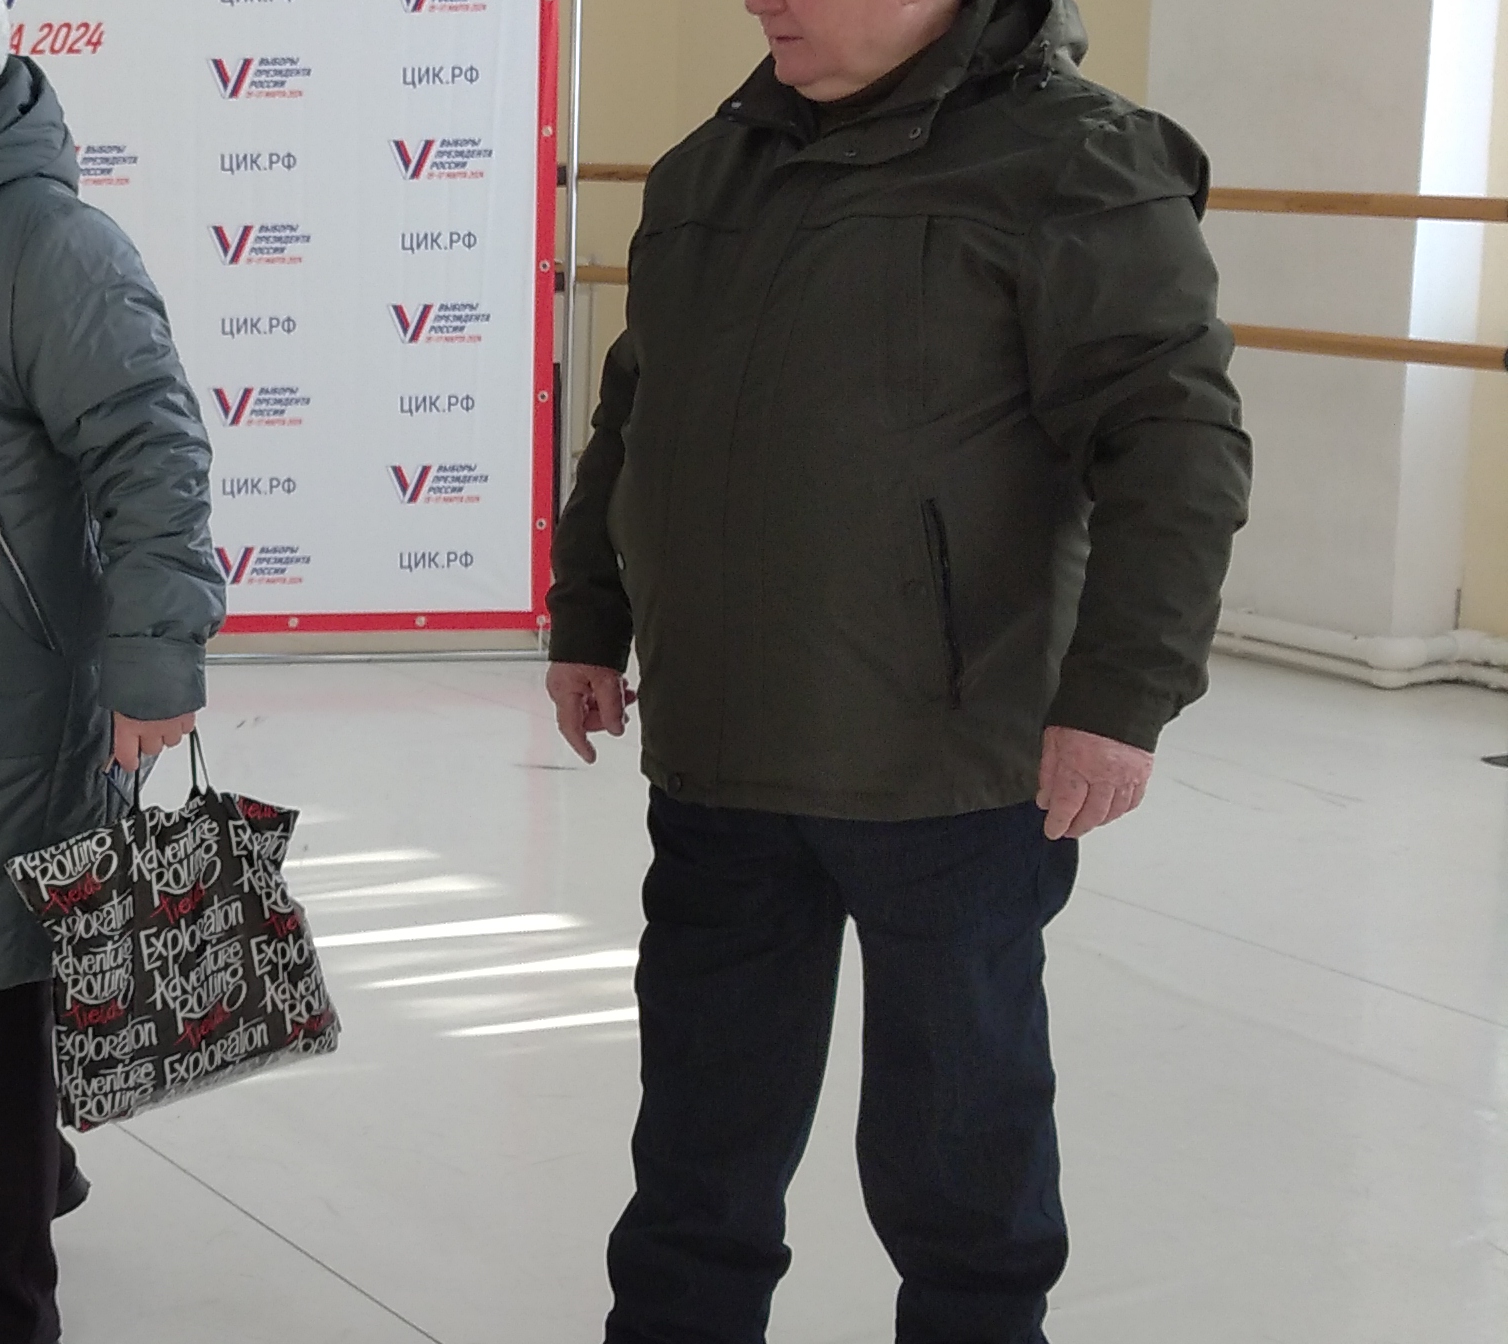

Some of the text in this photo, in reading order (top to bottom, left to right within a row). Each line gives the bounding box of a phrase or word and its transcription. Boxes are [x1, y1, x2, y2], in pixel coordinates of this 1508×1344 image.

[30, 21, 105, 55] 2024
[402, 64, 480, 89] ЦИК.РФ
[220, 151, 298, 176] ЦИК.РФ
[400, 230, 478, 255] ЦИК.РФ
[220, 315, 297, 340] ЦИК.РФ
[399, 394, 476, 418] ЦИК.РФ
[221, 476, 297, 499] ЦИК.РФ
[399, 550, 474, 573] ЦИК.РФ
